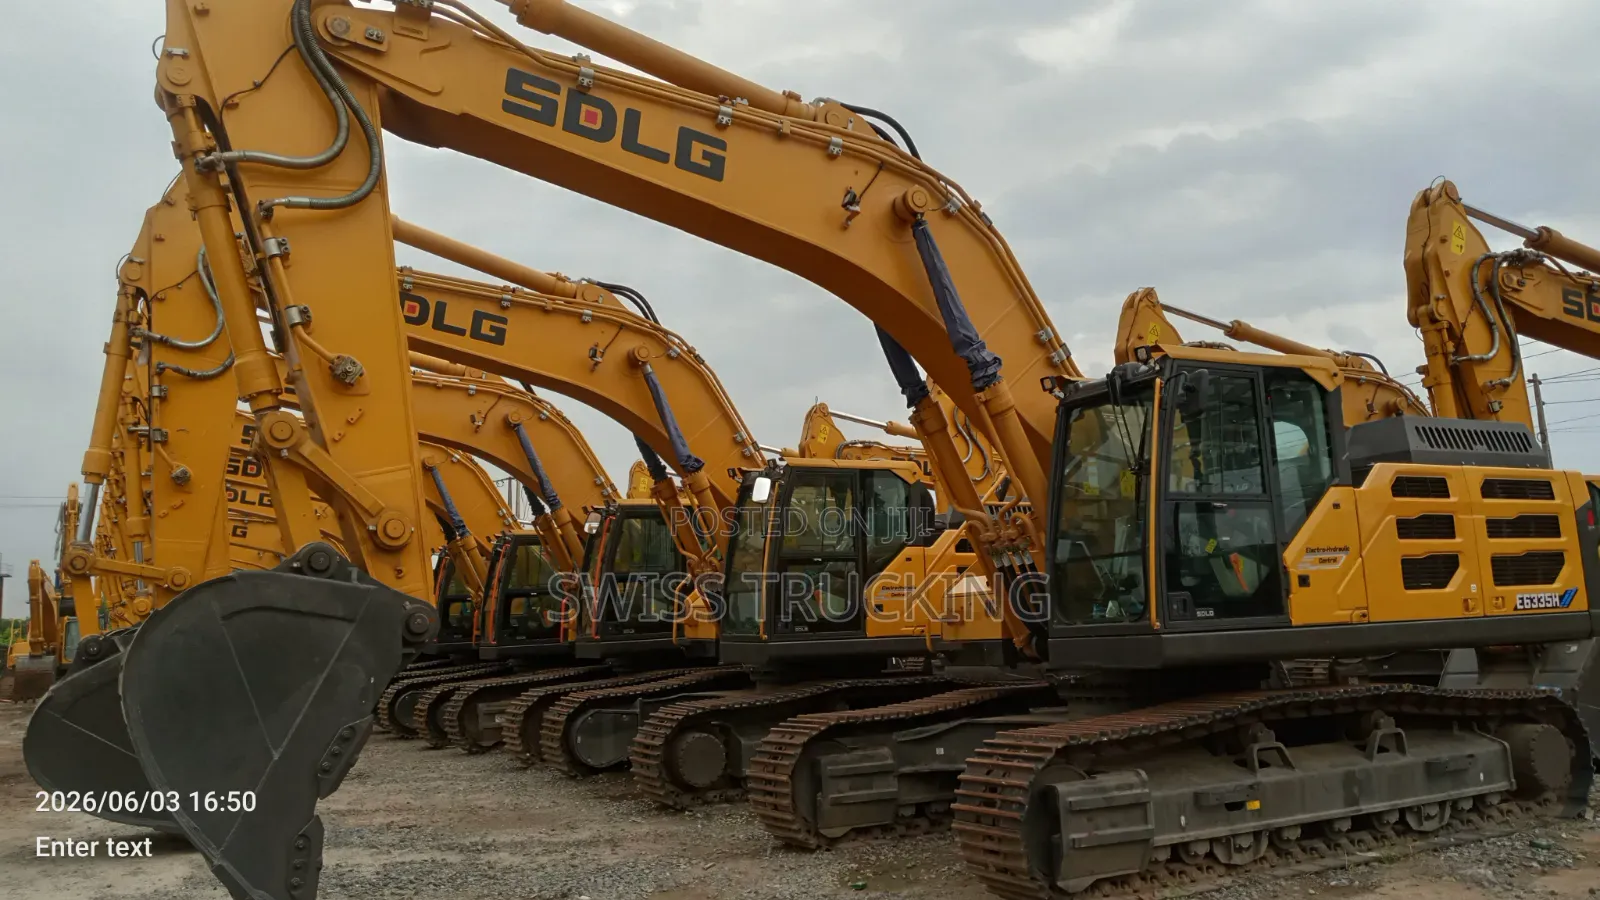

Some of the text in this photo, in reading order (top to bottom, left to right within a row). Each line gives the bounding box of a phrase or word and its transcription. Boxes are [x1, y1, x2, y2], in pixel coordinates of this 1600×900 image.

[502, 67, 727, 182] SDLG
[399, 291, 509, 346] DLG
[1562, 288, 1600, 324] SD
[226, 457, 263, 478] SD
[226, 486, 274, 508] DLG
